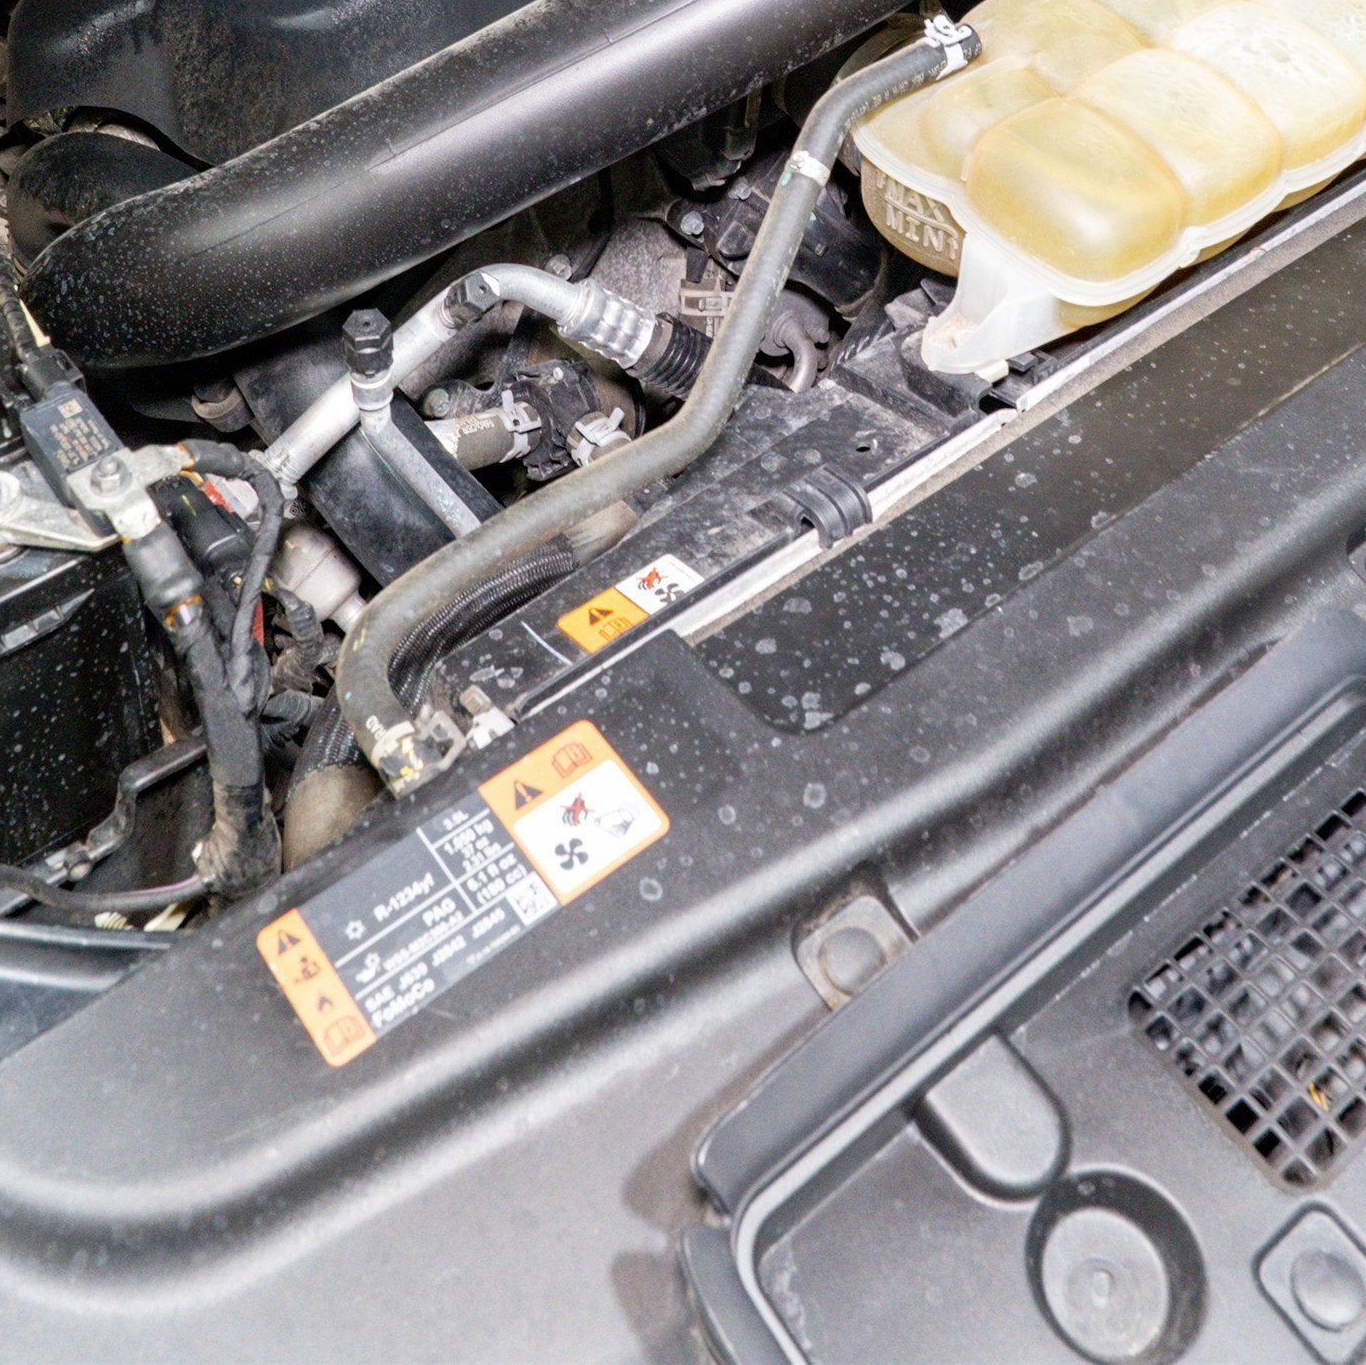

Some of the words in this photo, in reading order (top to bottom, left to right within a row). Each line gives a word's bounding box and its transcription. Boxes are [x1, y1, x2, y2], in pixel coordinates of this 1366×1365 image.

[885, 177, 945, 223] MAX
[885, 203, 944, 252] MIN
[472, 816, 495, 838] kg
[371, 871, 438, 924] R-1234yf
[420, 895, 458, 928] PAG
[369, 973, 437, 1030] FoMoCo
